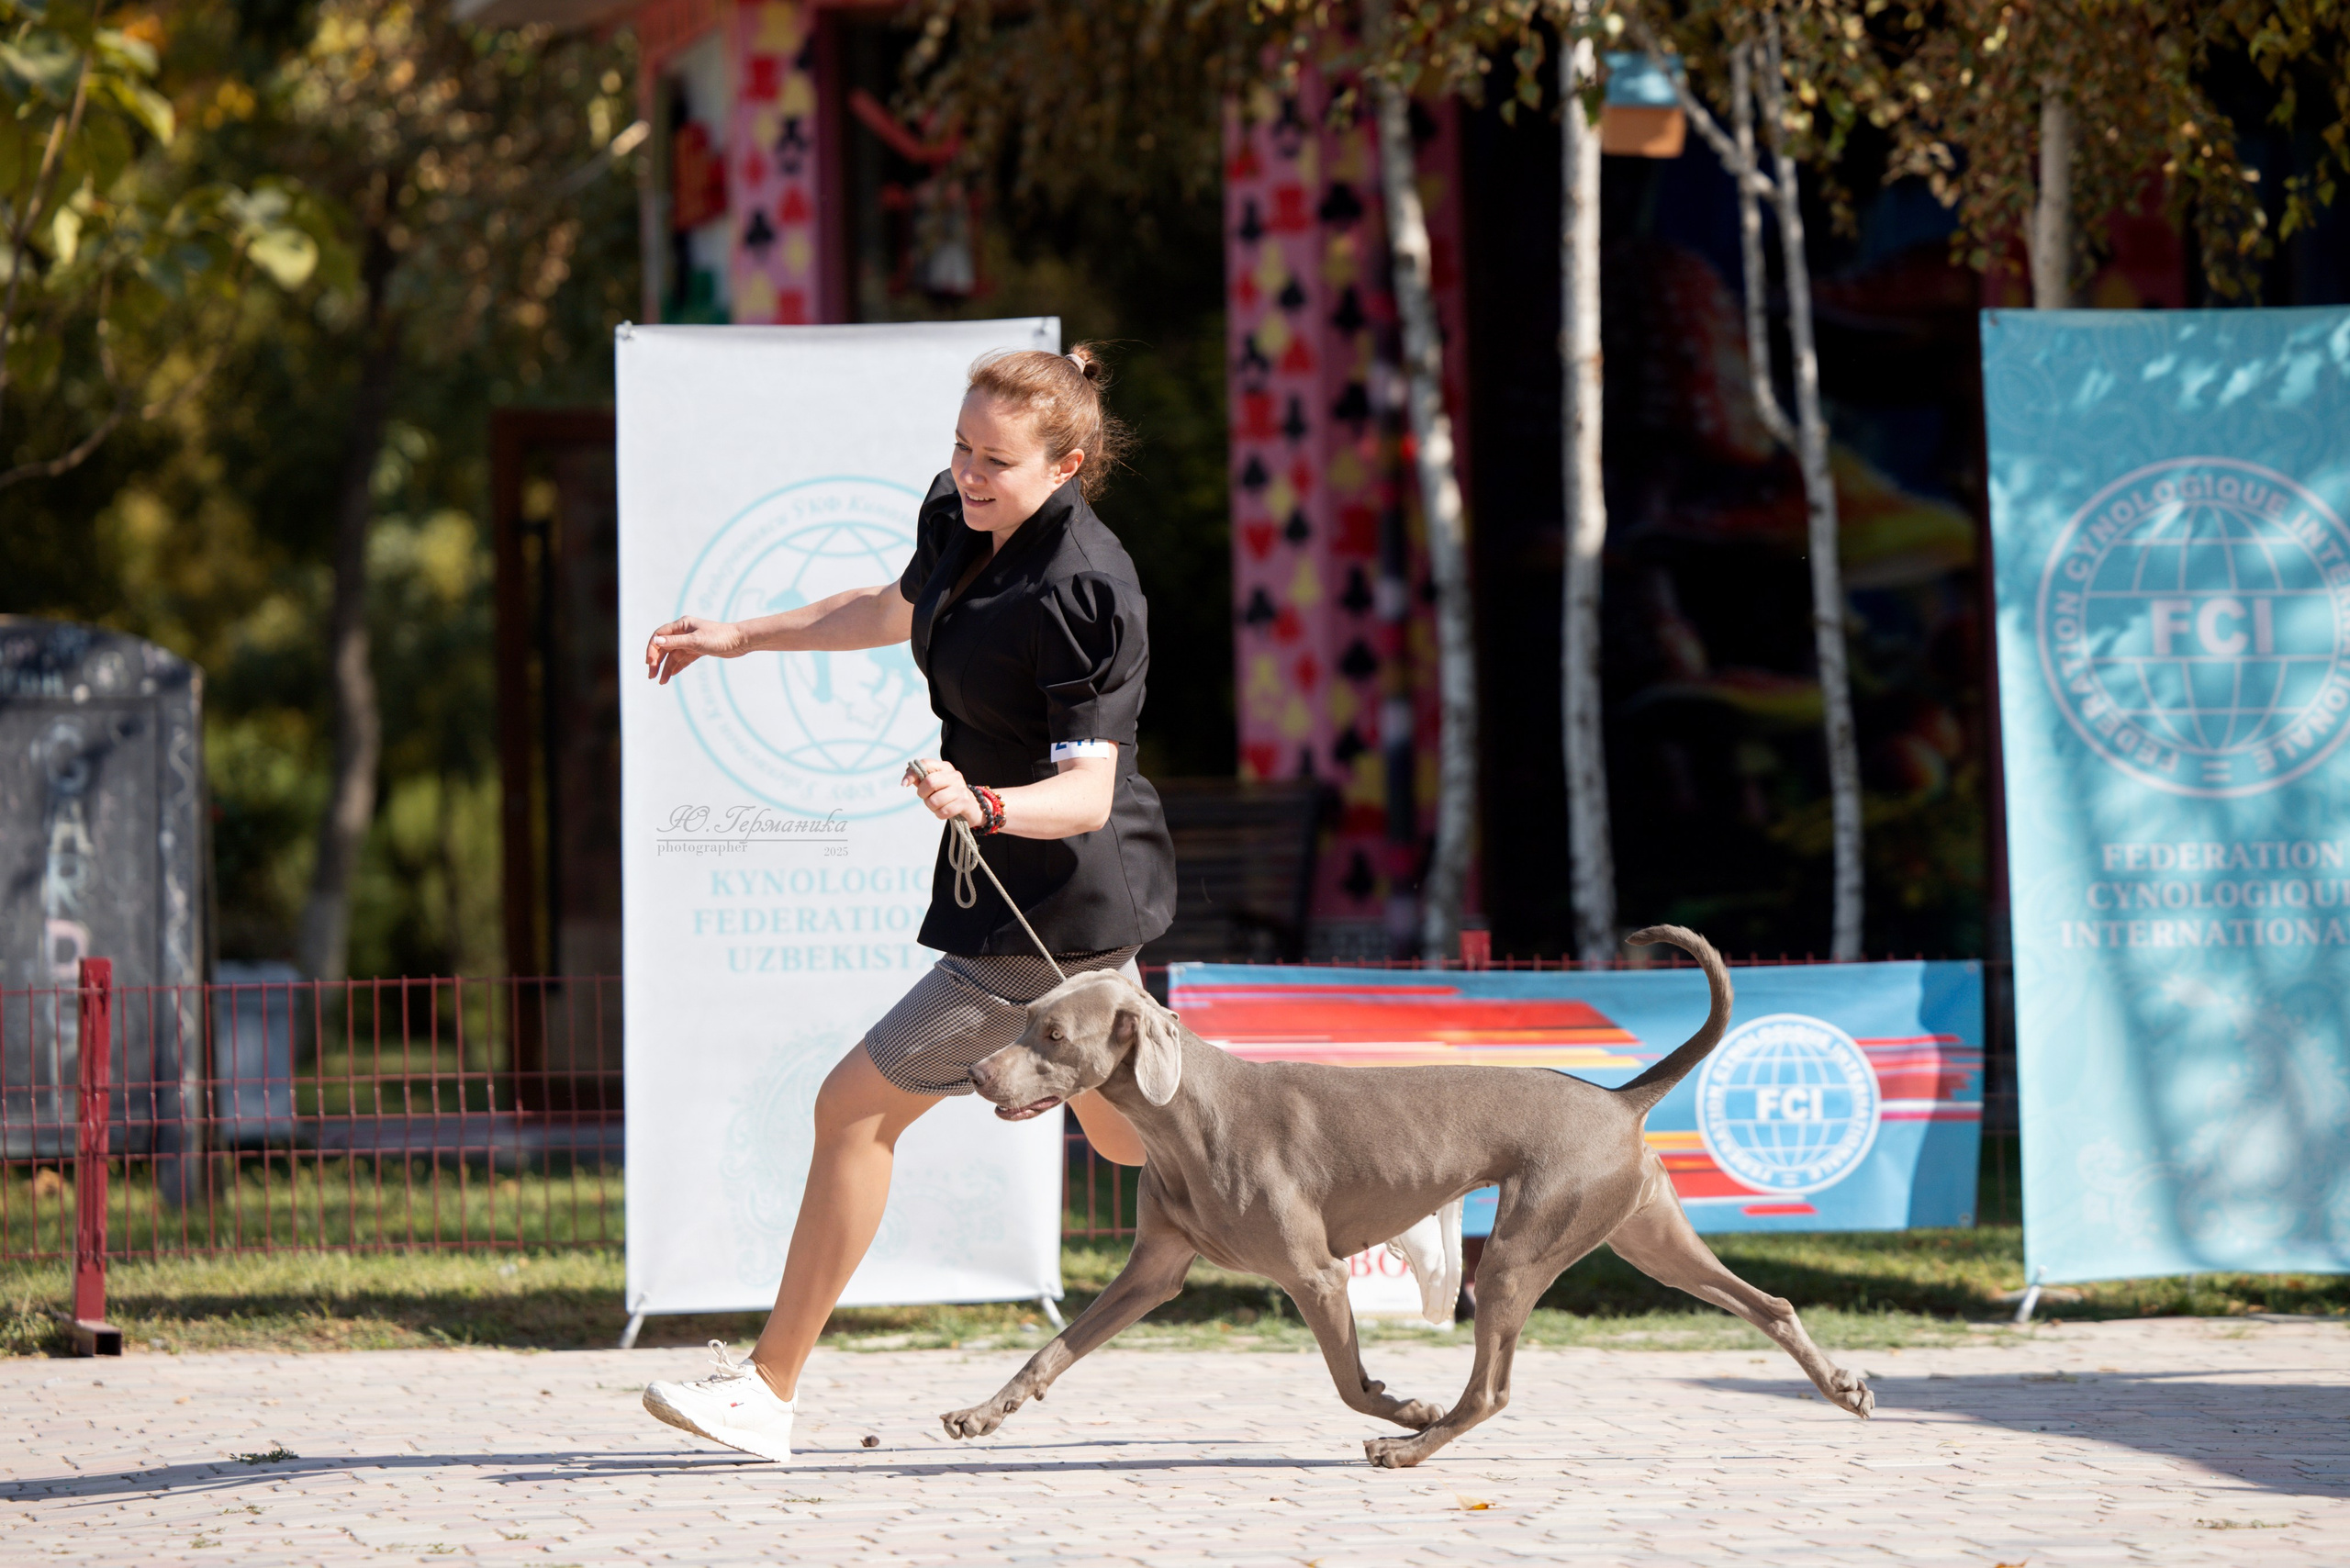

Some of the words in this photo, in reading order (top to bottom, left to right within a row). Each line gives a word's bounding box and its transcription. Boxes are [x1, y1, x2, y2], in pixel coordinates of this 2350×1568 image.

[2065, 473, 2289, 581] CYNOLOGIQUE
[2151, 599, 2274, 655] FCI
[2102, 840, 2344, 872] FEDERATION
[711, 866, 934, 897] KYNOLOGIC
[2061, 916, 2350, 948] INTERNATIONA
[1755, 1088, 1823, 1123] FCI
